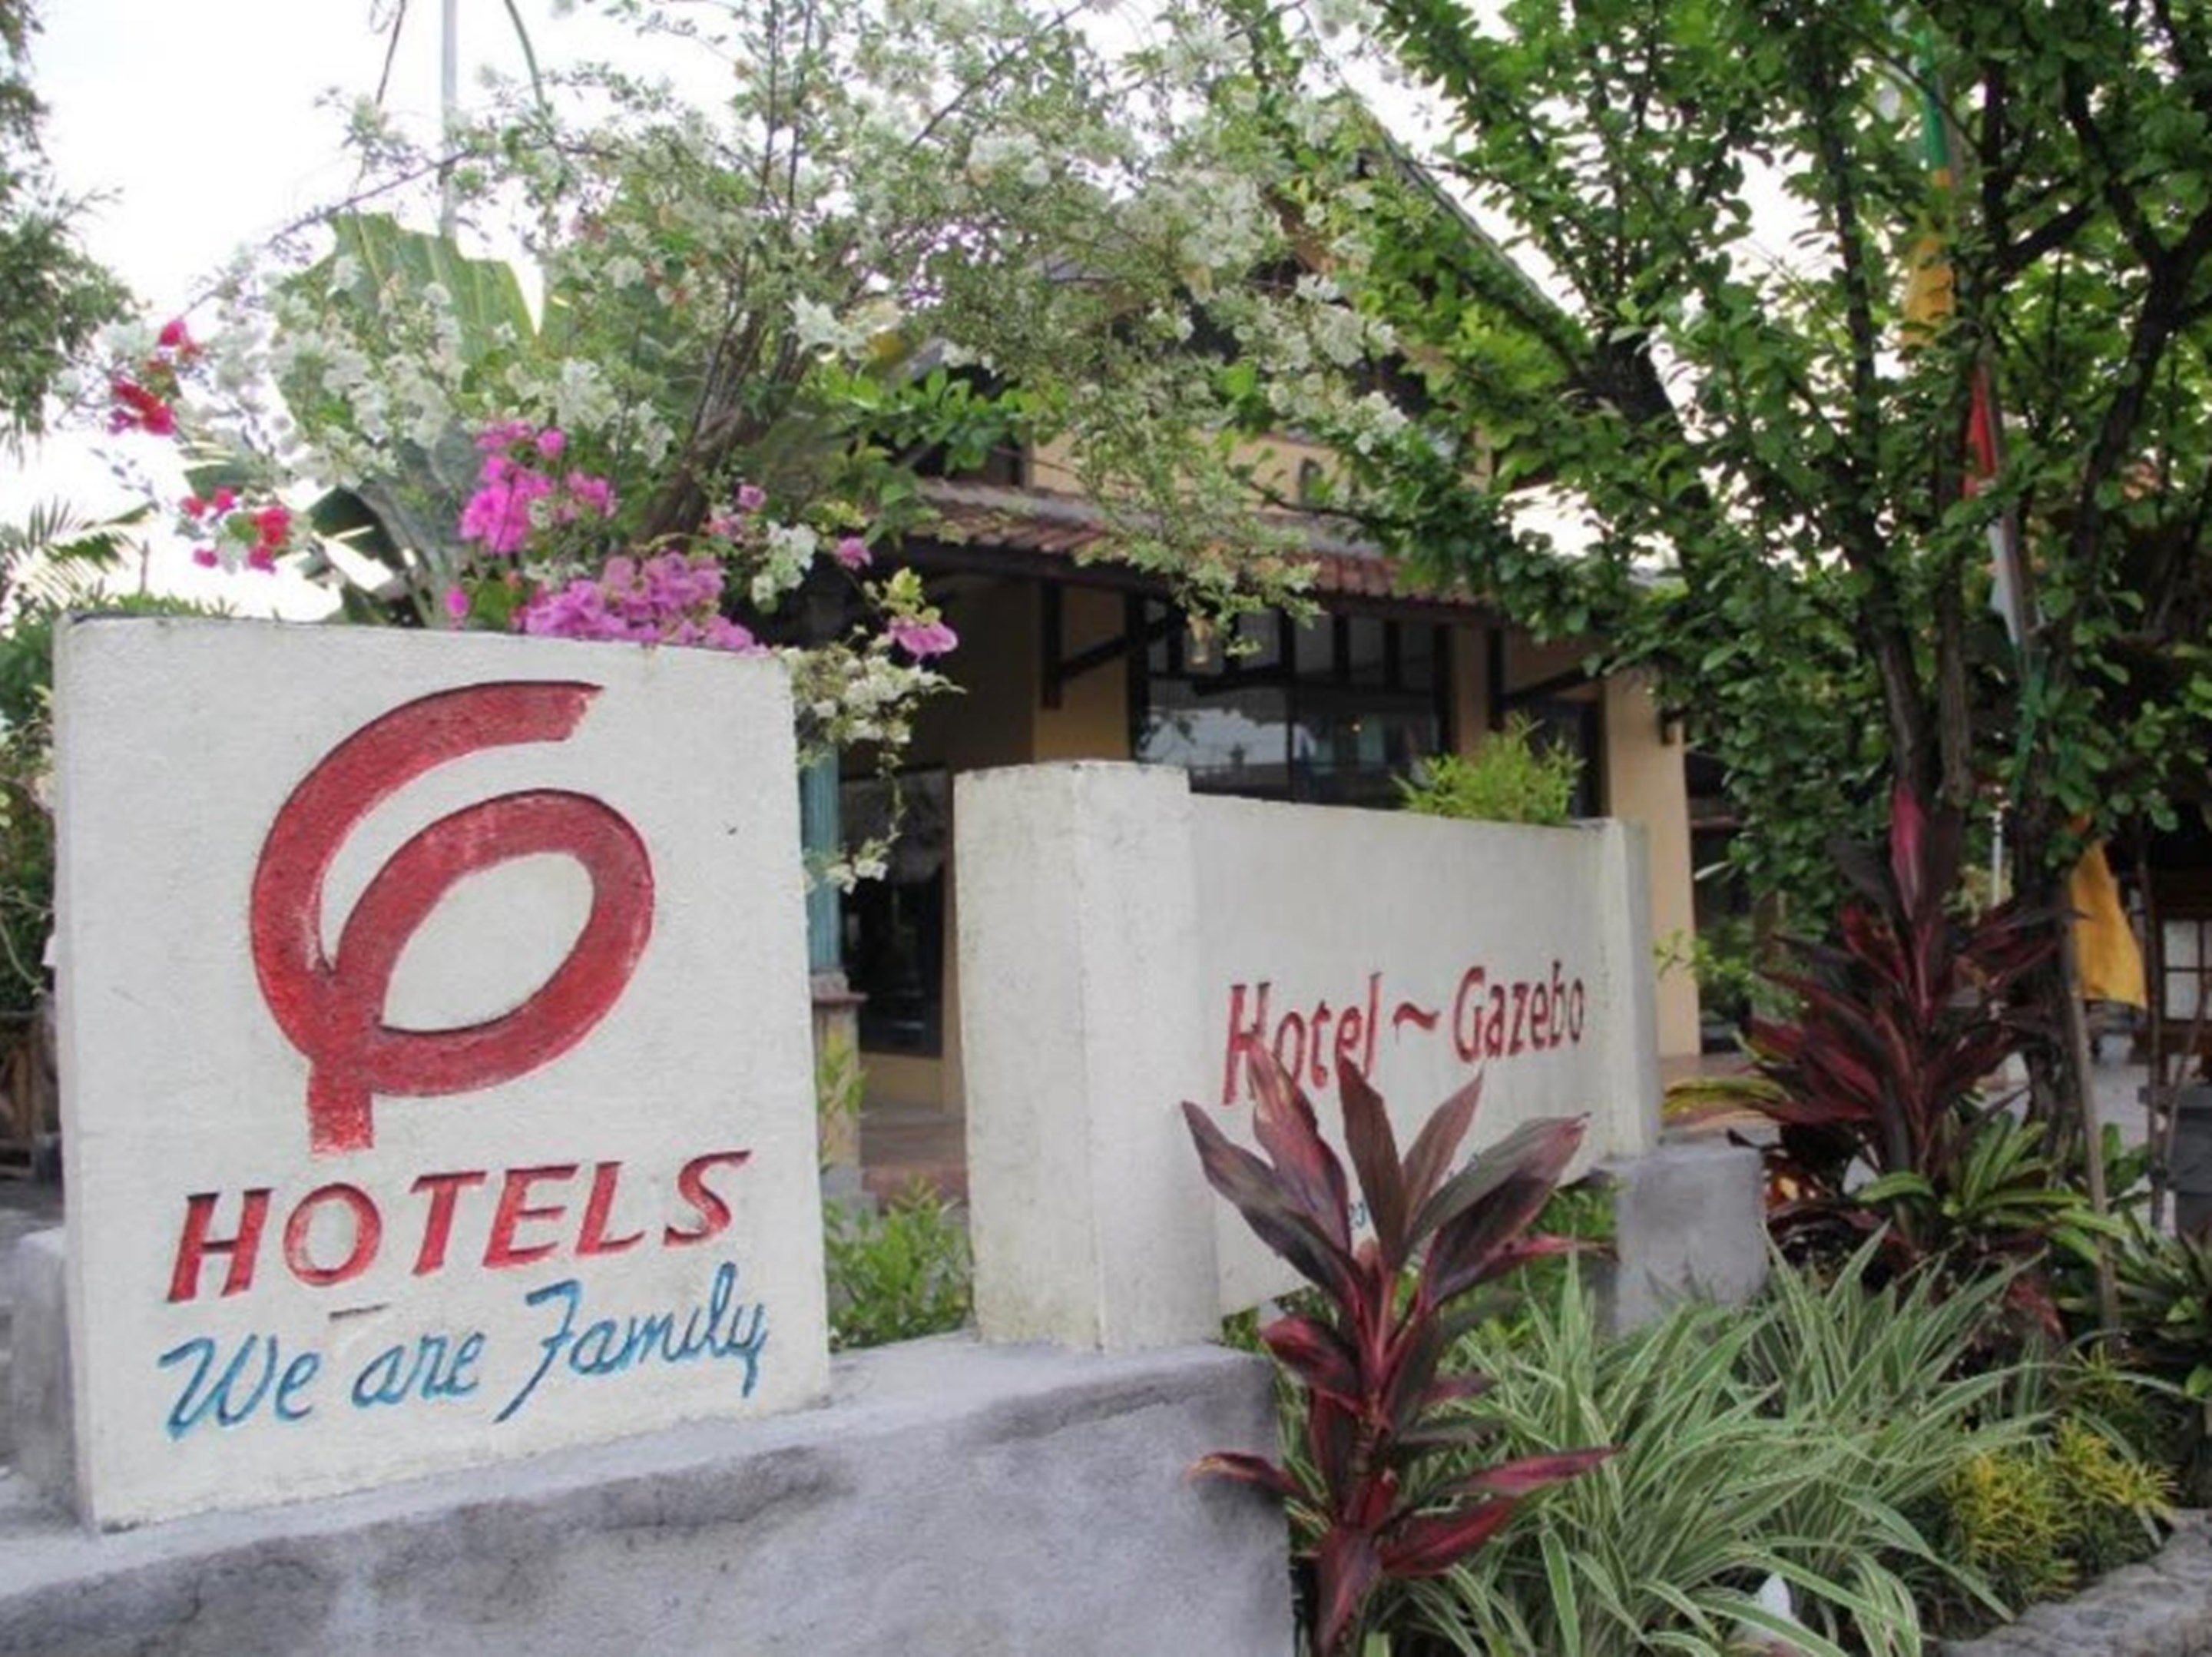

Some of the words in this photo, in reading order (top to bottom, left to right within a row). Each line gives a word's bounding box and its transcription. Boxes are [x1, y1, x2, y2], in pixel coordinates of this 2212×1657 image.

[1221, 970, 1382, 1106] Hotel
[1452, 959, 1585, 1064] Gazebo
[164, 1148, 753, 1304] HOTELS
[157, 1331, 321, 1441] We
[349, 1330, 487, 1408] are
[494, 1261, 768, 1425] Family
